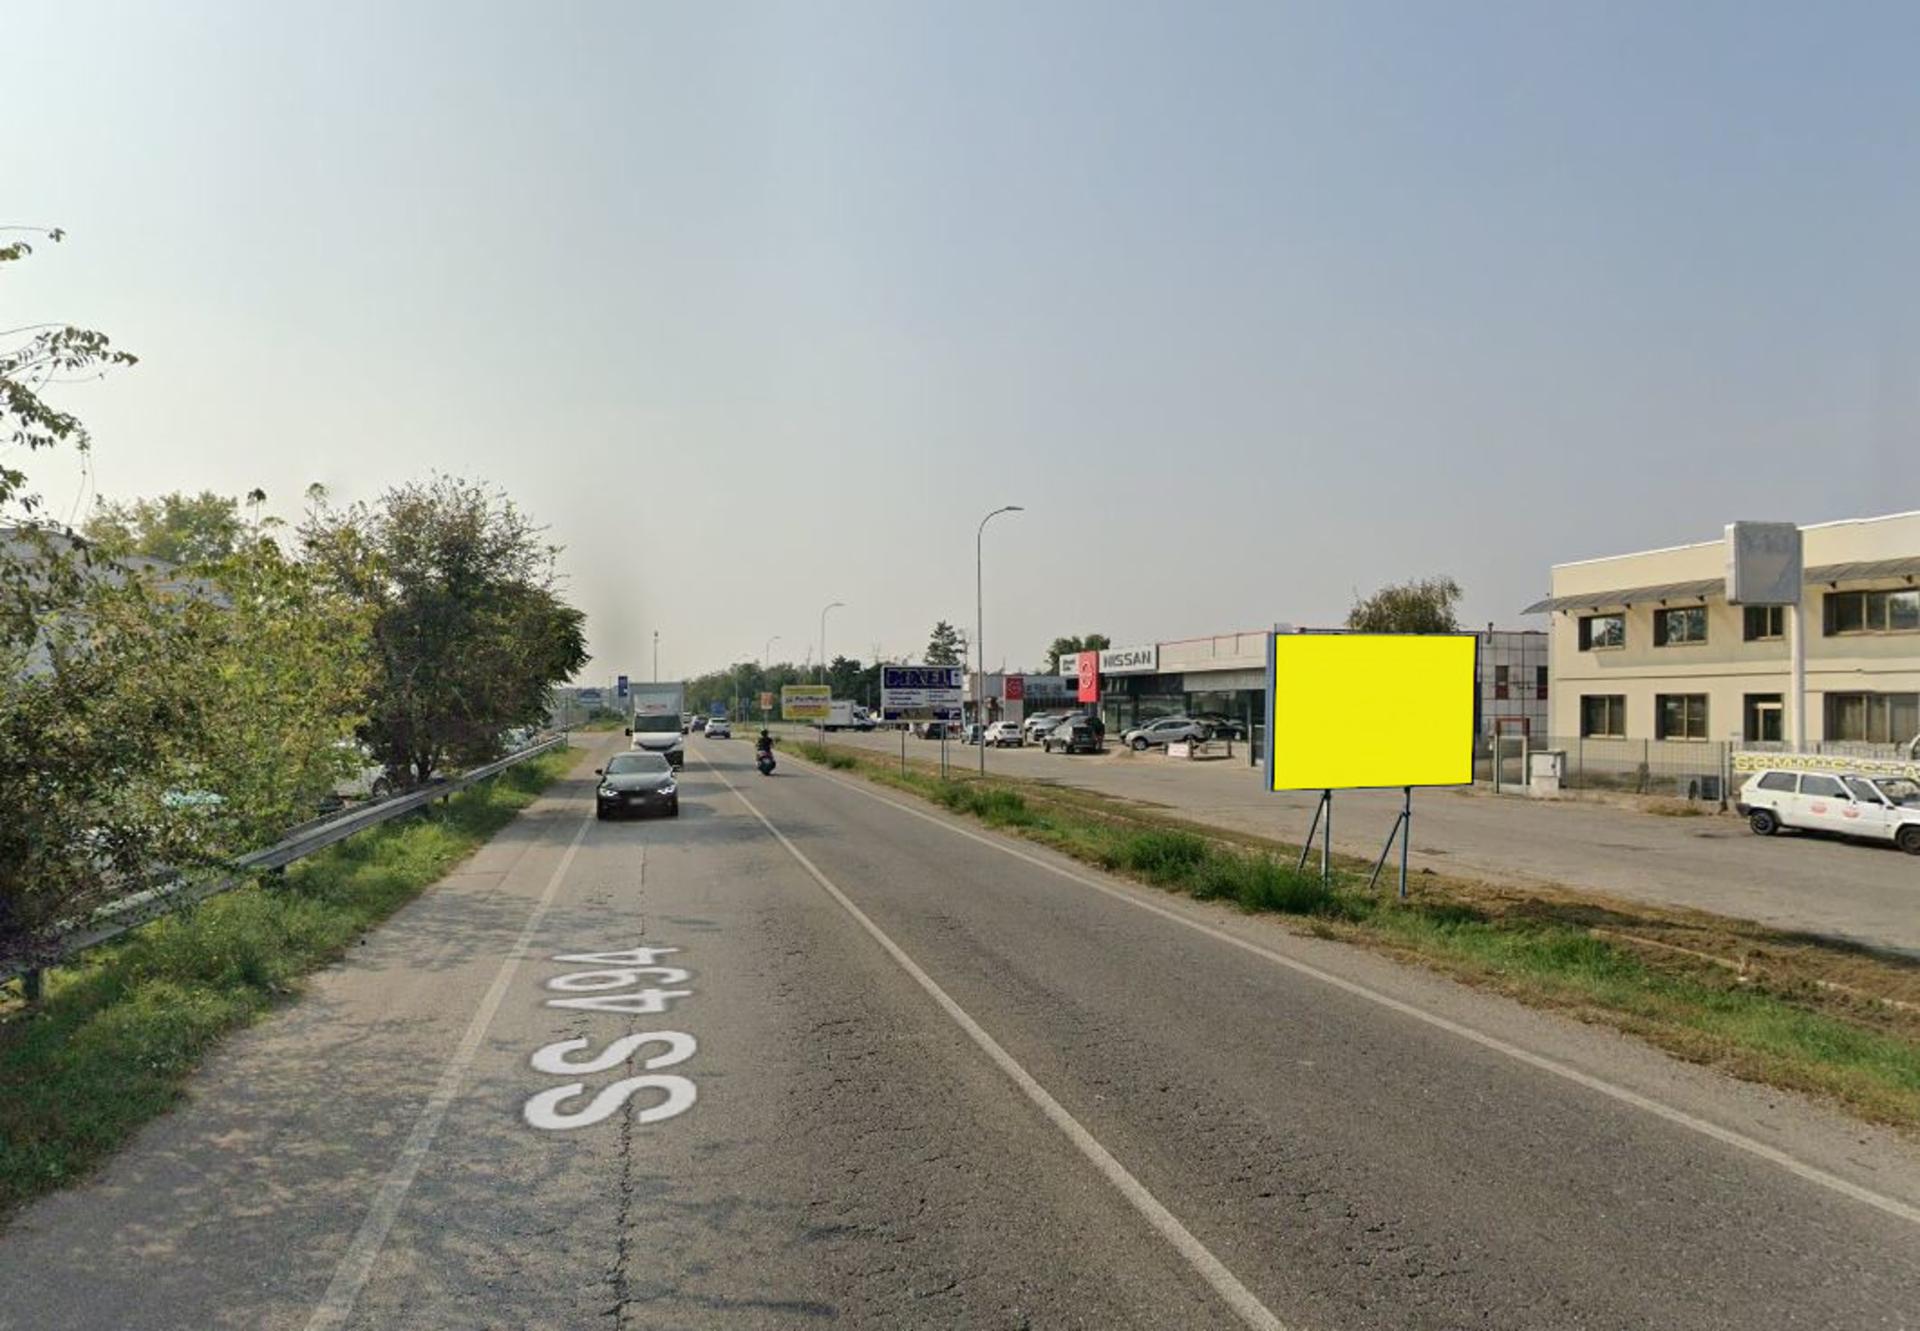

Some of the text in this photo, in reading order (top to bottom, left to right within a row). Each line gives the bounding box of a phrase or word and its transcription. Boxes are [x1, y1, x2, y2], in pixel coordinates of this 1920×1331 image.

[1103, 651, 1151, 668] NISSAN
[524, 947, 697, 1130] SS 494
